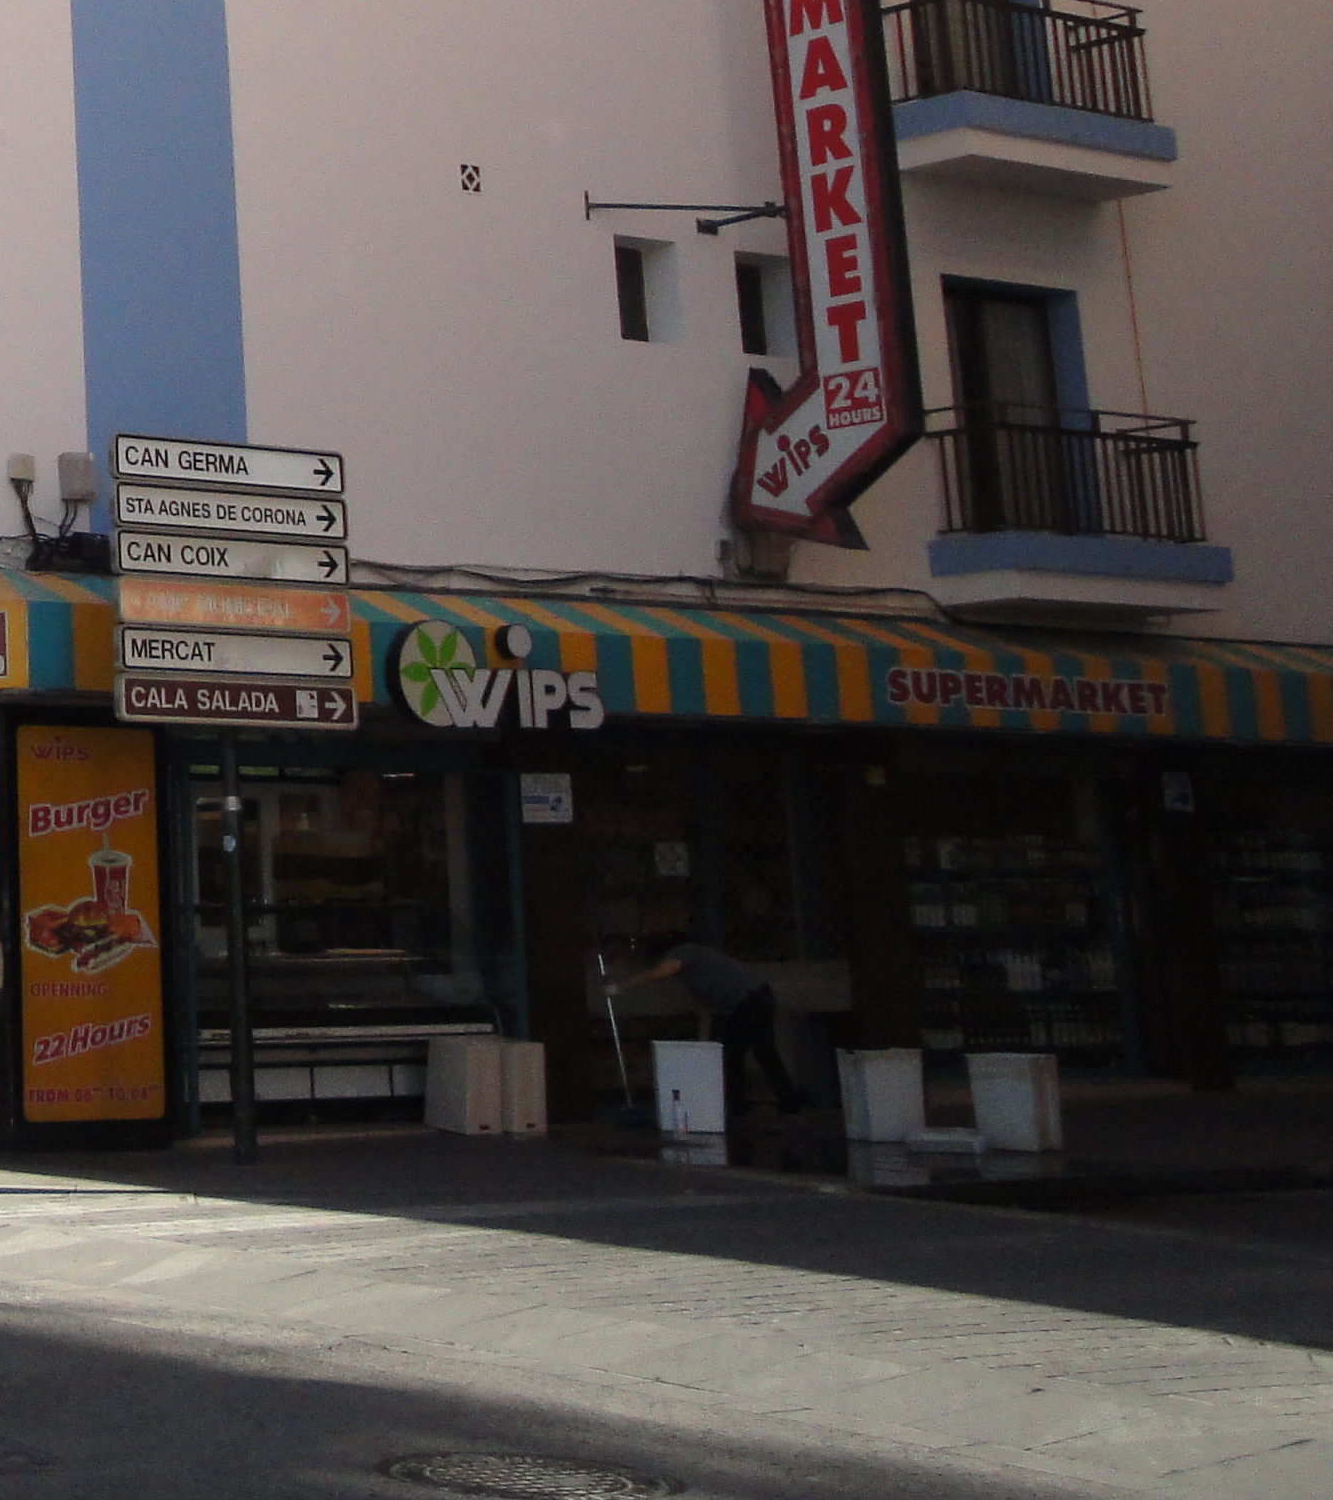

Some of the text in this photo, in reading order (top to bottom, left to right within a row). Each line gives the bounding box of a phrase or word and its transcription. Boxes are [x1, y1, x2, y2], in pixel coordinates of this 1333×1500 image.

[828, 371, 879, 409] 24
[828, 406, 881, 427] HOURS
[125, 446, 249, 476] CAN GERMA
[126, 498, 307, 526] STA AGNES DE CORONA
[126, 541, 229, 567] CAN COIX
[131, 639, 215, 662] MERCAT
[131, 687, 279, 713] CALA SALADA
[888, 669, 1166, 714] SUPERMARKET
[29, 788, 149, 837] Burger
[30, 982, 107, 998] OPENNING
[33, 1013, 151, 1065] 22 Hours
